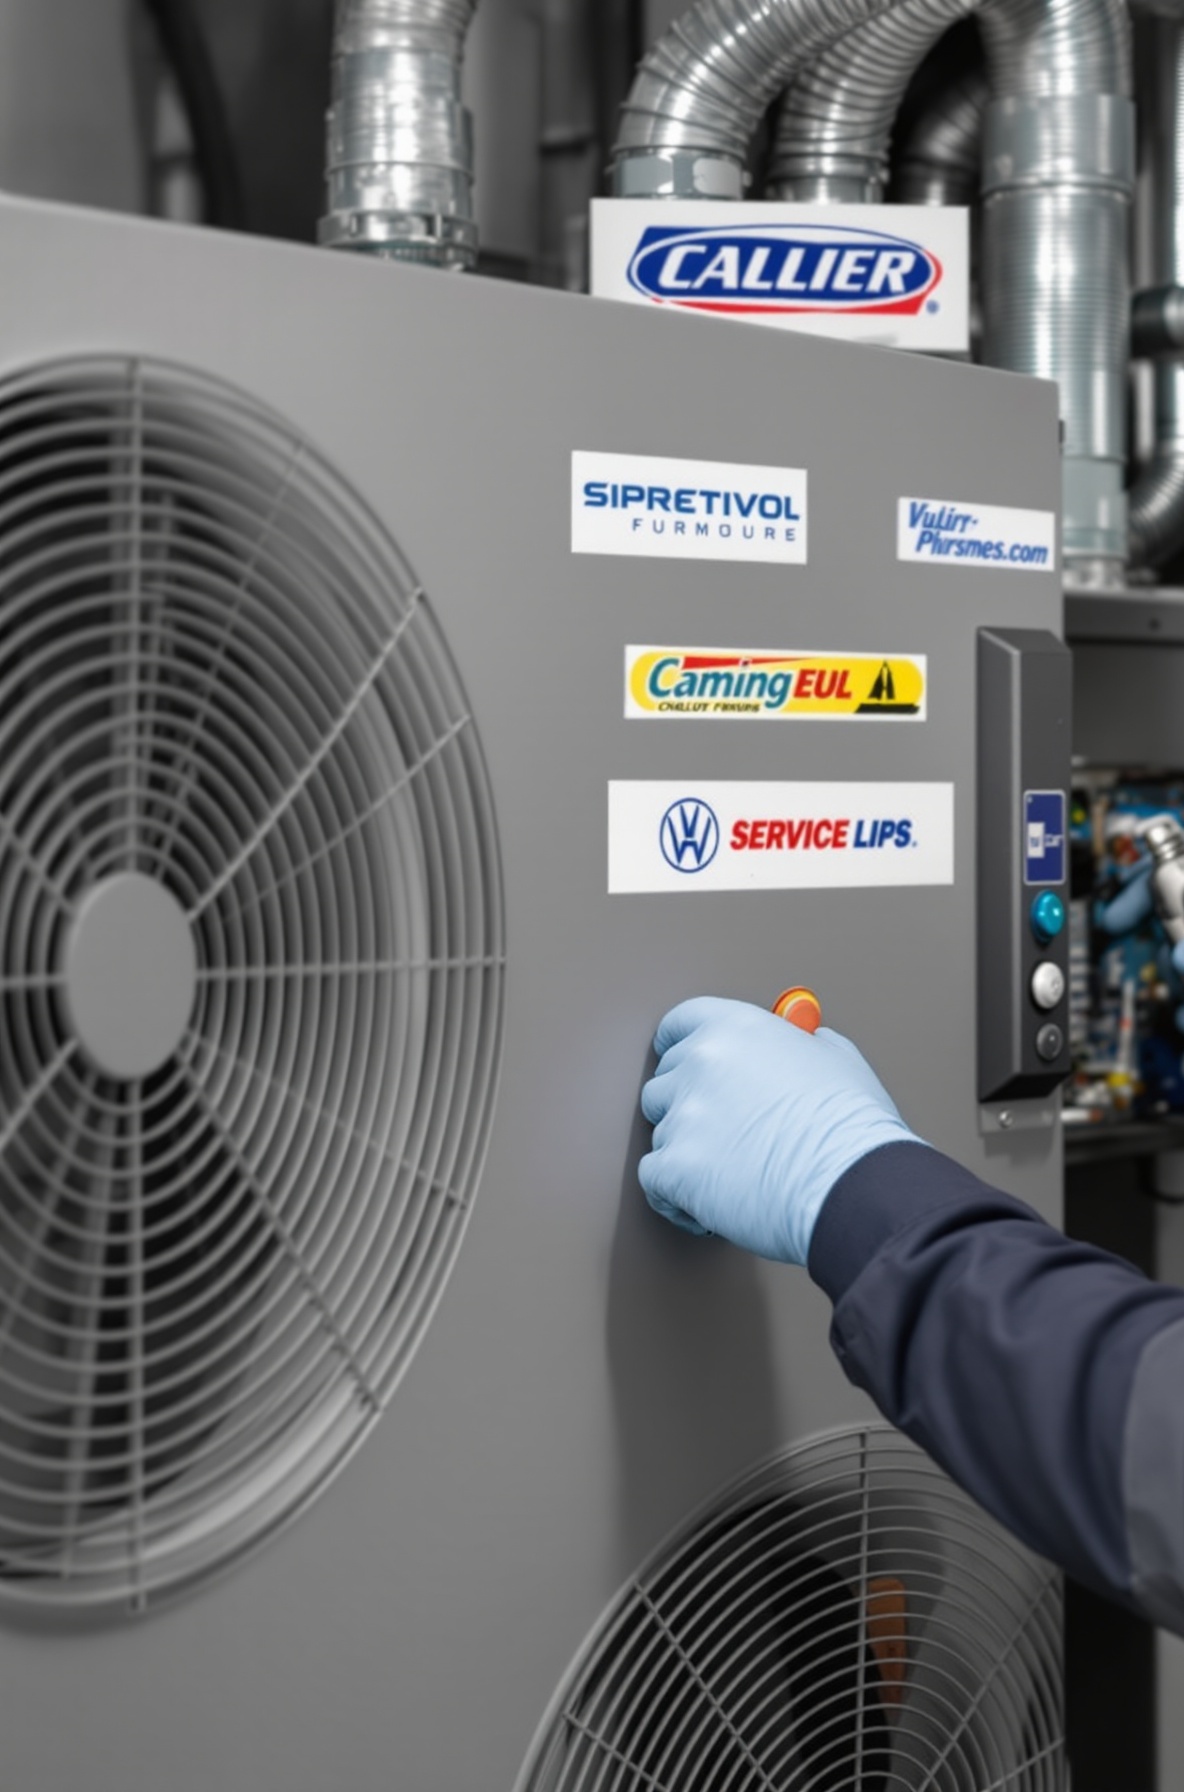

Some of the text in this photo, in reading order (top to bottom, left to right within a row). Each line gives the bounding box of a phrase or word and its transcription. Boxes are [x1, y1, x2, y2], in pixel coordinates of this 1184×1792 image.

[658, 244, 916, 293] CALLIER
[583, 481, 800, 521] SIPRETIVOL
[632, 518, 797, 541] FURMOURE
[730, 819, 849, 851] SERVICE
